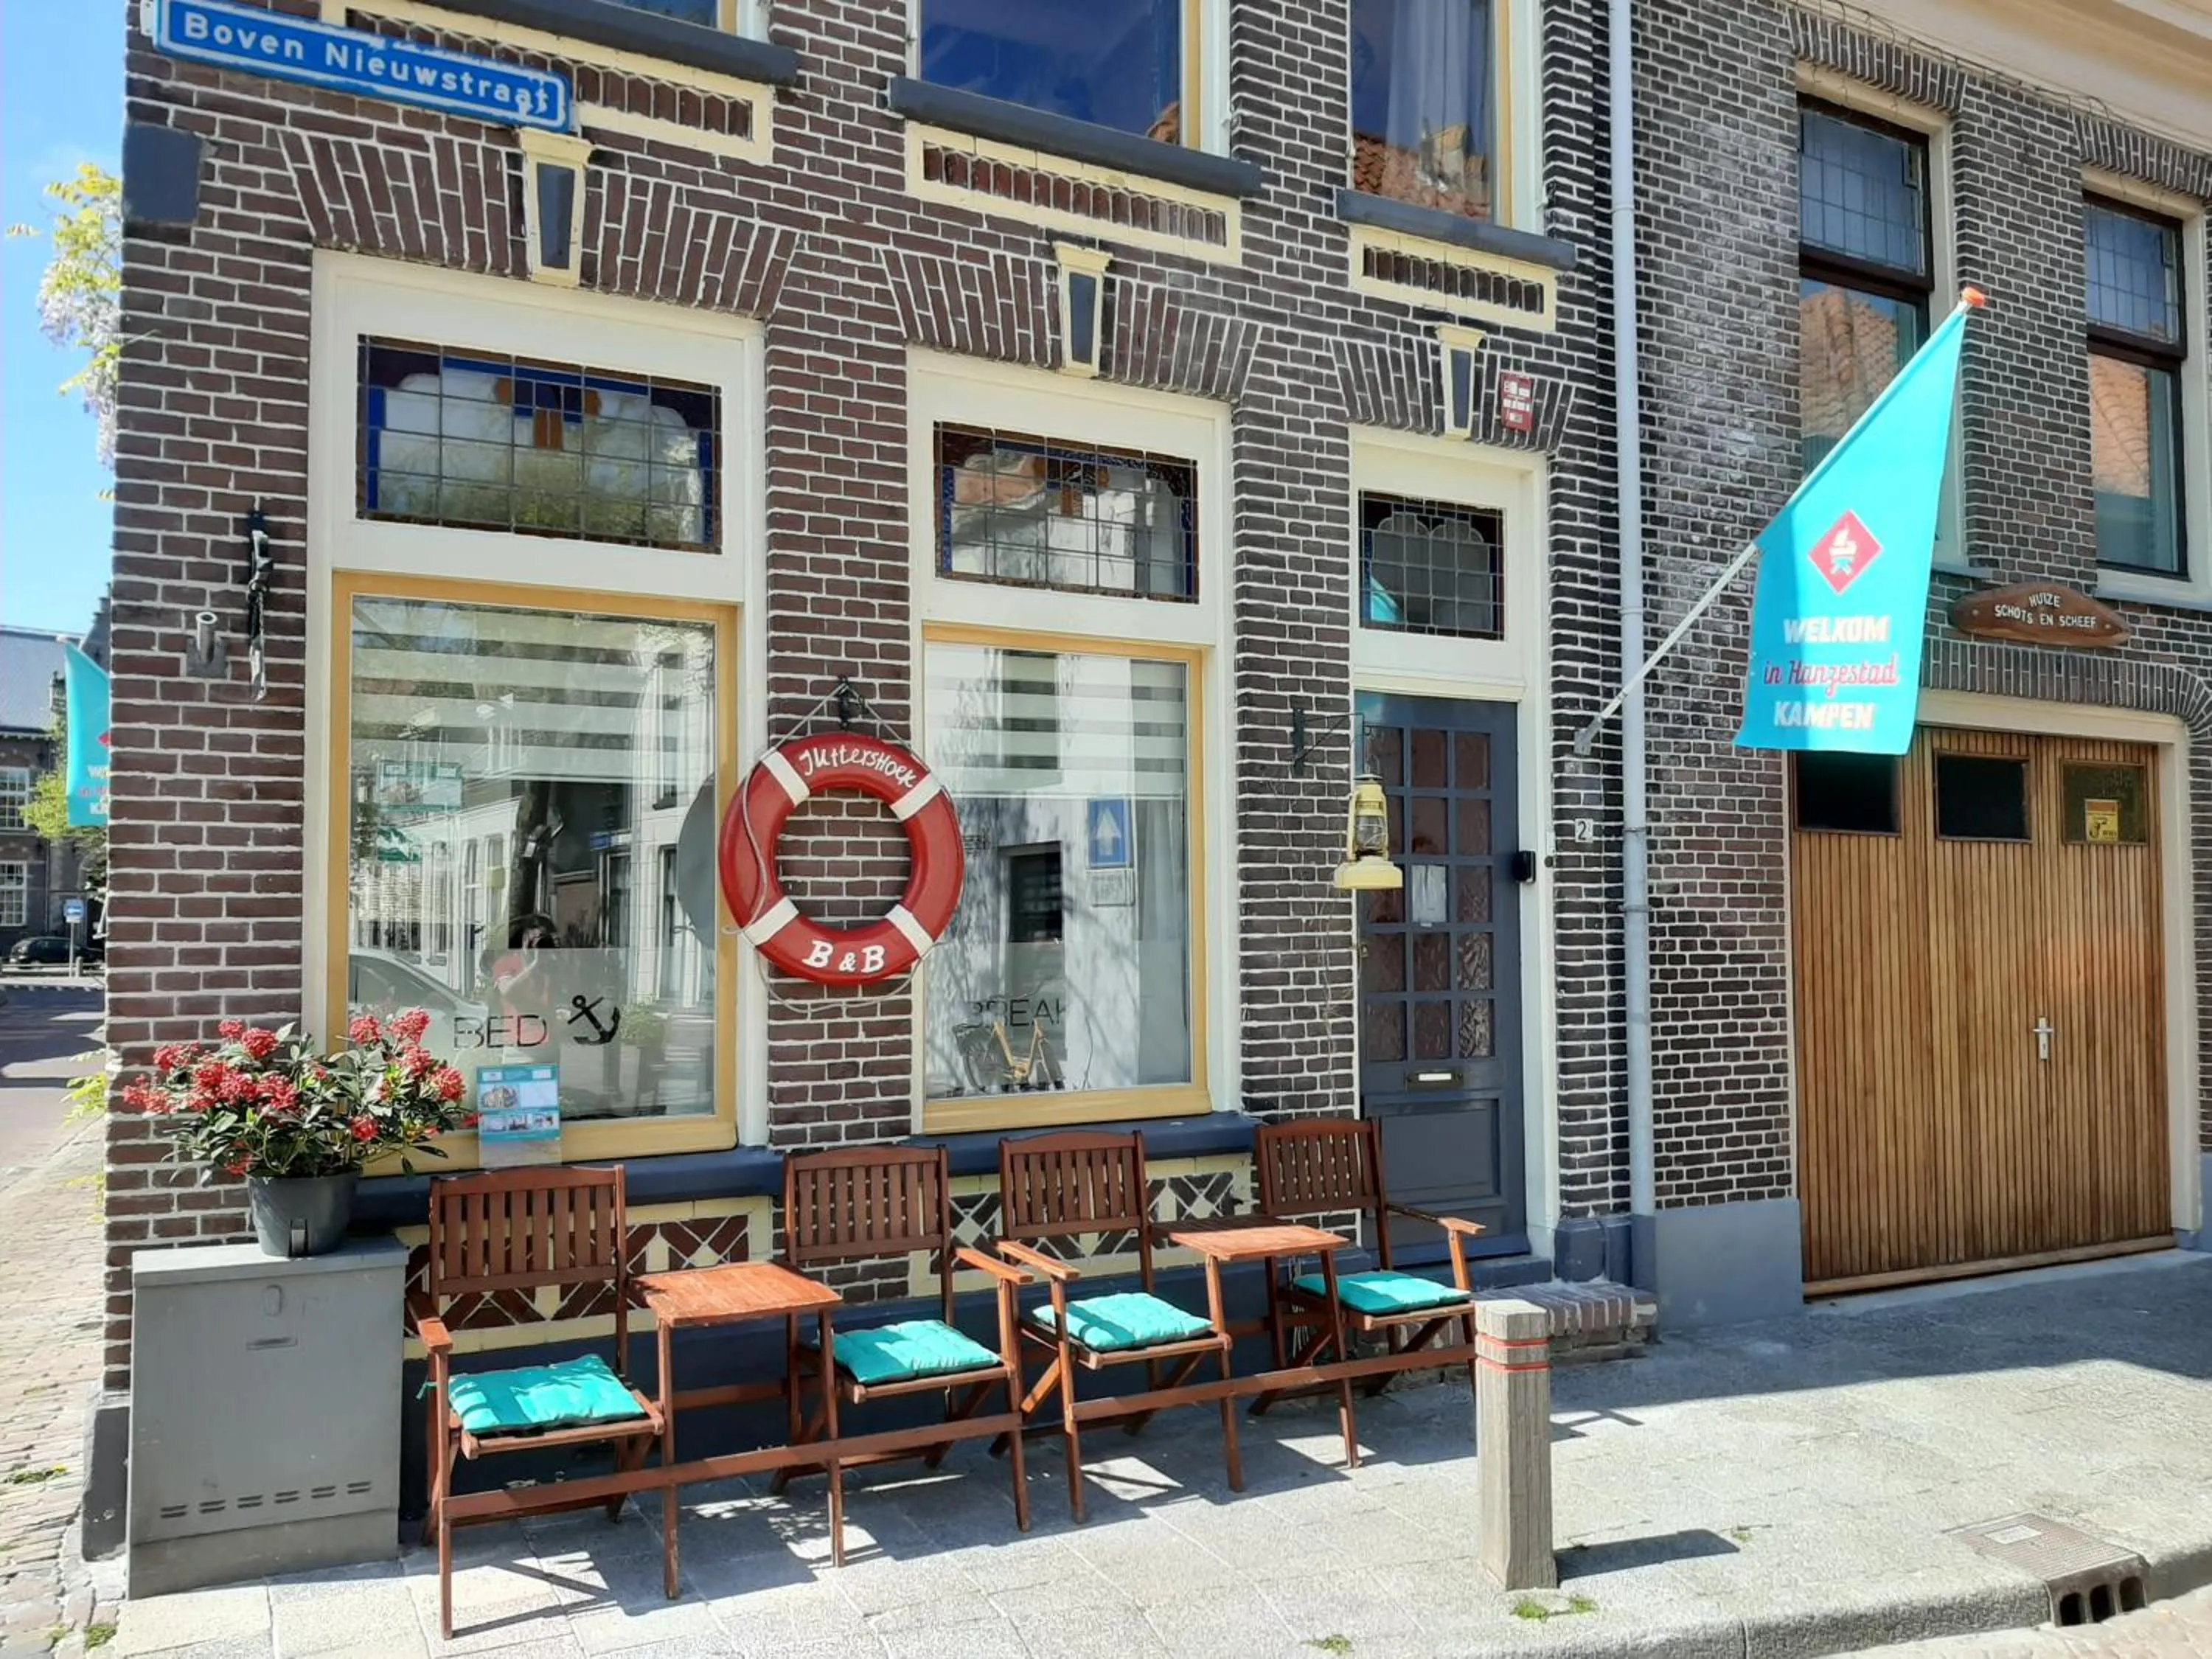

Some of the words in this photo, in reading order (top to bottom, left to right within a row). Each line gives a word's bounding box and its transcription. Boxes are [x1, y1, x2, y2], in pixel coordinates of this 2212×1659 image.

[185, 11, 304, 60] Boven
[325, 41, 549, 114] Nieuwstraat
[1783, 614, 1891, 644] WELKOM
[1994, 604, 2034, 625] SCHOTS
[2039, 613, 2053, 626] EN
[2059, 615, 2097, 629] SCHEEF
[1764, 661, 1783, 684] in
[1788, 652, 1899, 698] Hanzestad
[1773, 700, 1875, 730] KAMPEN
[453, 1014, 548, 1048] BED
